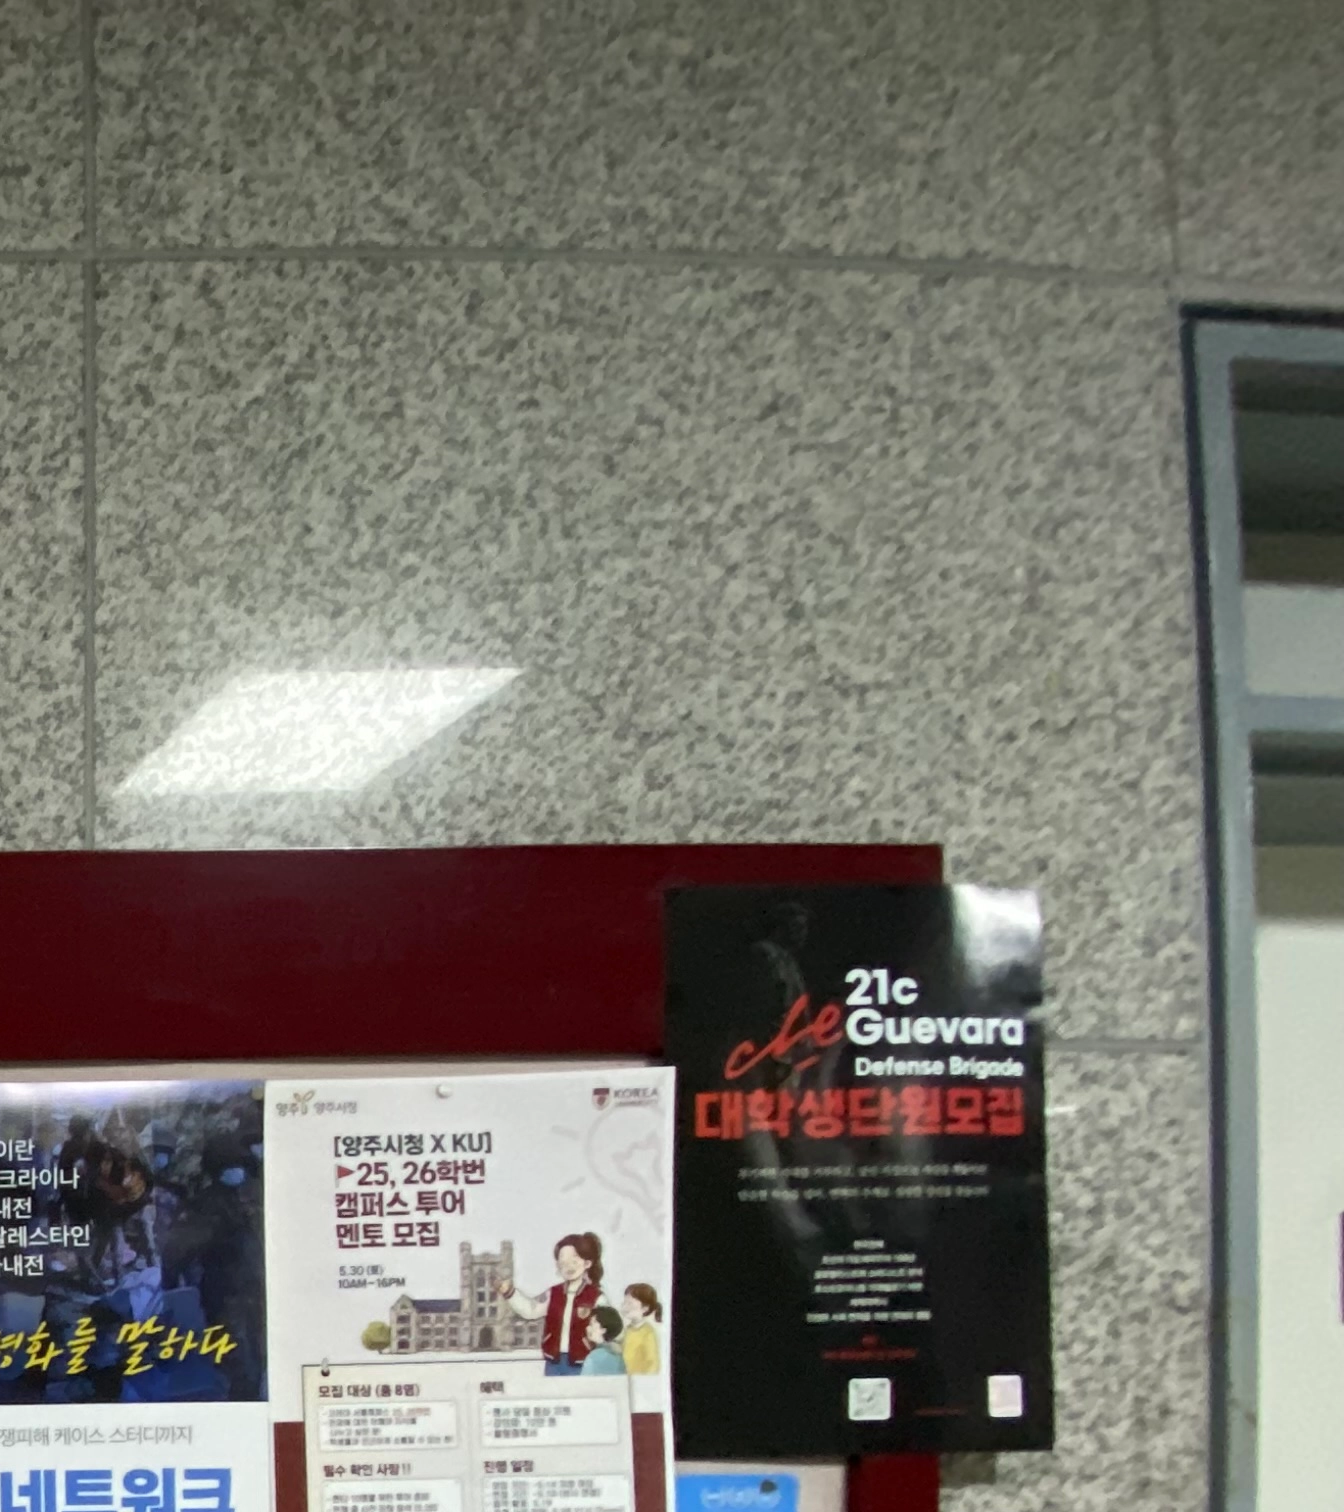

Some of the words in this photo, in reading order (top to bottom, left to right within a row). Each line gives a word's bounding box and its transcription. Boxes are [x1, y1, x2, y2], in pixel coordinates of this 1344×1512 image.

[844, 968, 918, 1006] 21c
[846, 1008, 1024, 1046] Guevara
[854, 1057, 944, 1077] Defense
[949, 1057, 1024, 1079] Brigade
[613, 1087, 659, 1098] KOREA
[333, 1134, 424, 1157] [양주시청
[430, 1135, 446, 1154] X
[452, 1131, 492, 1154] KU]
[356, 1163, 395, 1188] 25,
[403, 1159, 486, 1185] 26학번
[335, 1192, 410, 1217] 캠퍼스
[415, 1190, 465, 1215] 투어
[336, 1223, 386, 1249] 멘토
[392, 1221, 440, 1248] 모집
[339, 1265, 364, 1276] 5.30
[118, 1316, 237, 1376] 말하다
[319, 1385, 343, 1398] 모집
[348, 1384, 371, 1397] 대상
[54, 1425, 106, 1445] 케이스
[109, 1425, 194, 1446] 스터디까지
